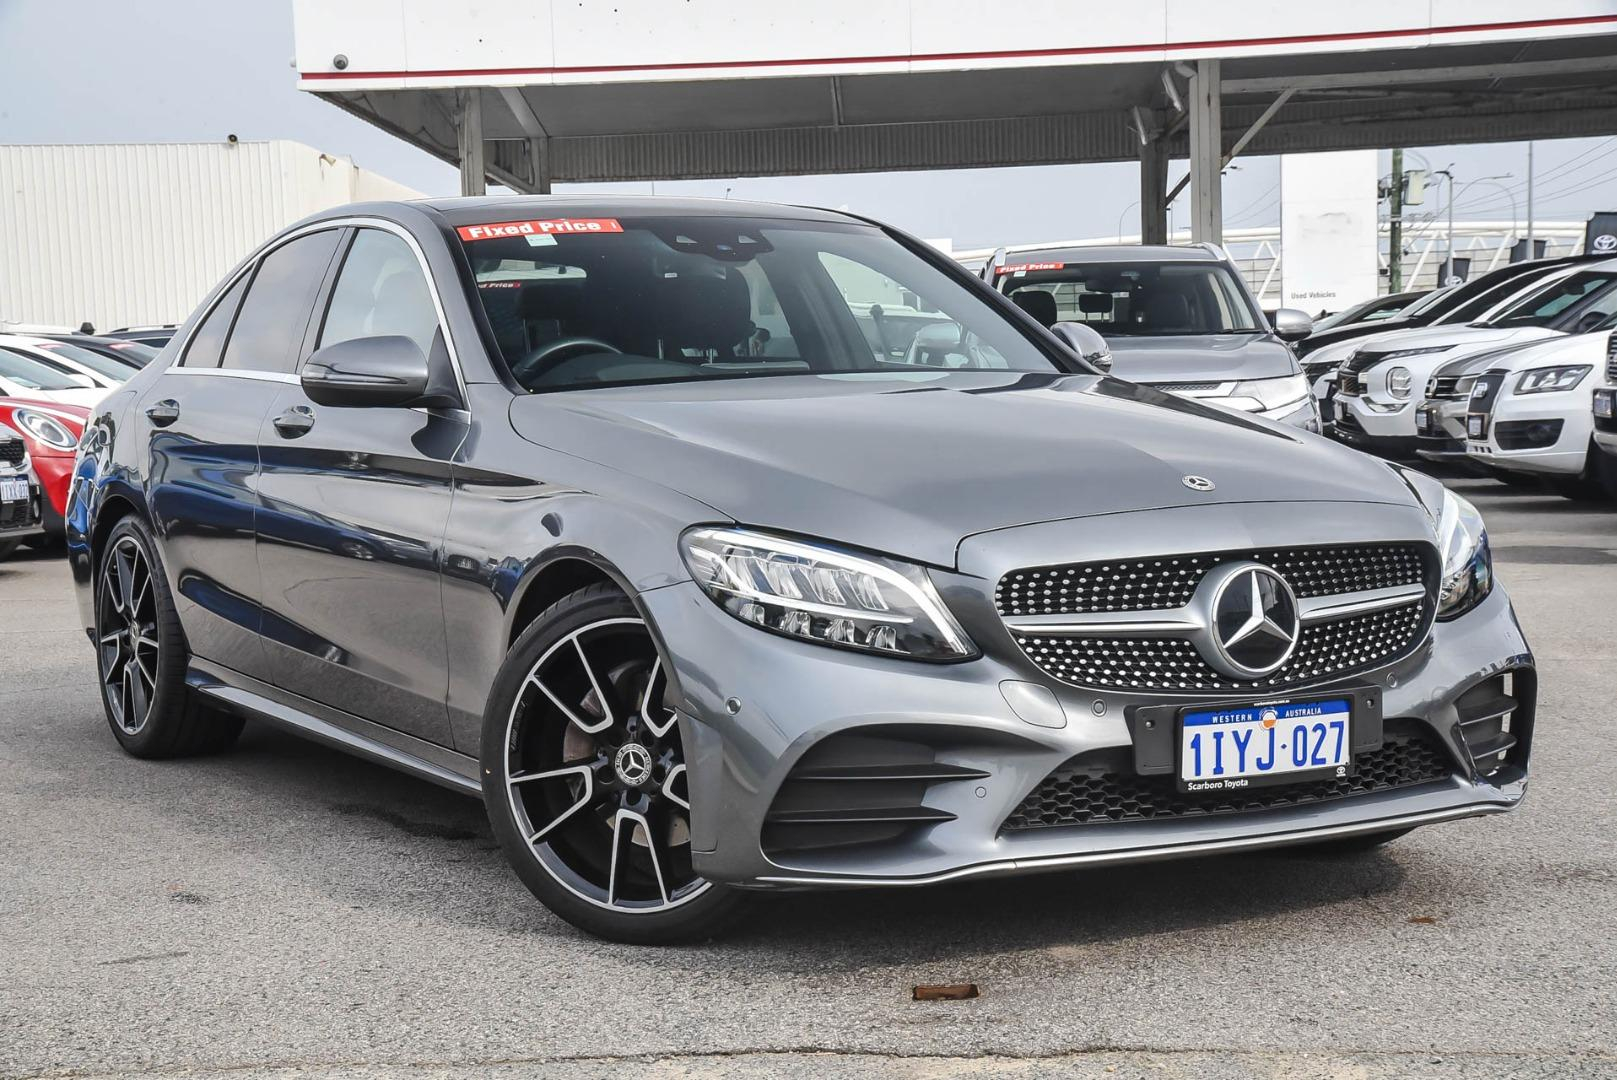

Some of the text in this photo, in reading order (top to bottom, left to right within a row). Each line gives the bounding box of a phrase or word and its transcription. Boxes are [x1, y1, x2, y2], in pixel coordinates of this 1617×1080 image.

[468, 219, 535, 239] Fixed
[538, 219, 602, 234] Price
[1212, 707, 1322, 723] WESTERN AUSTRALIA
[1187, 778, 1249, 791] Scarboro Toyota
